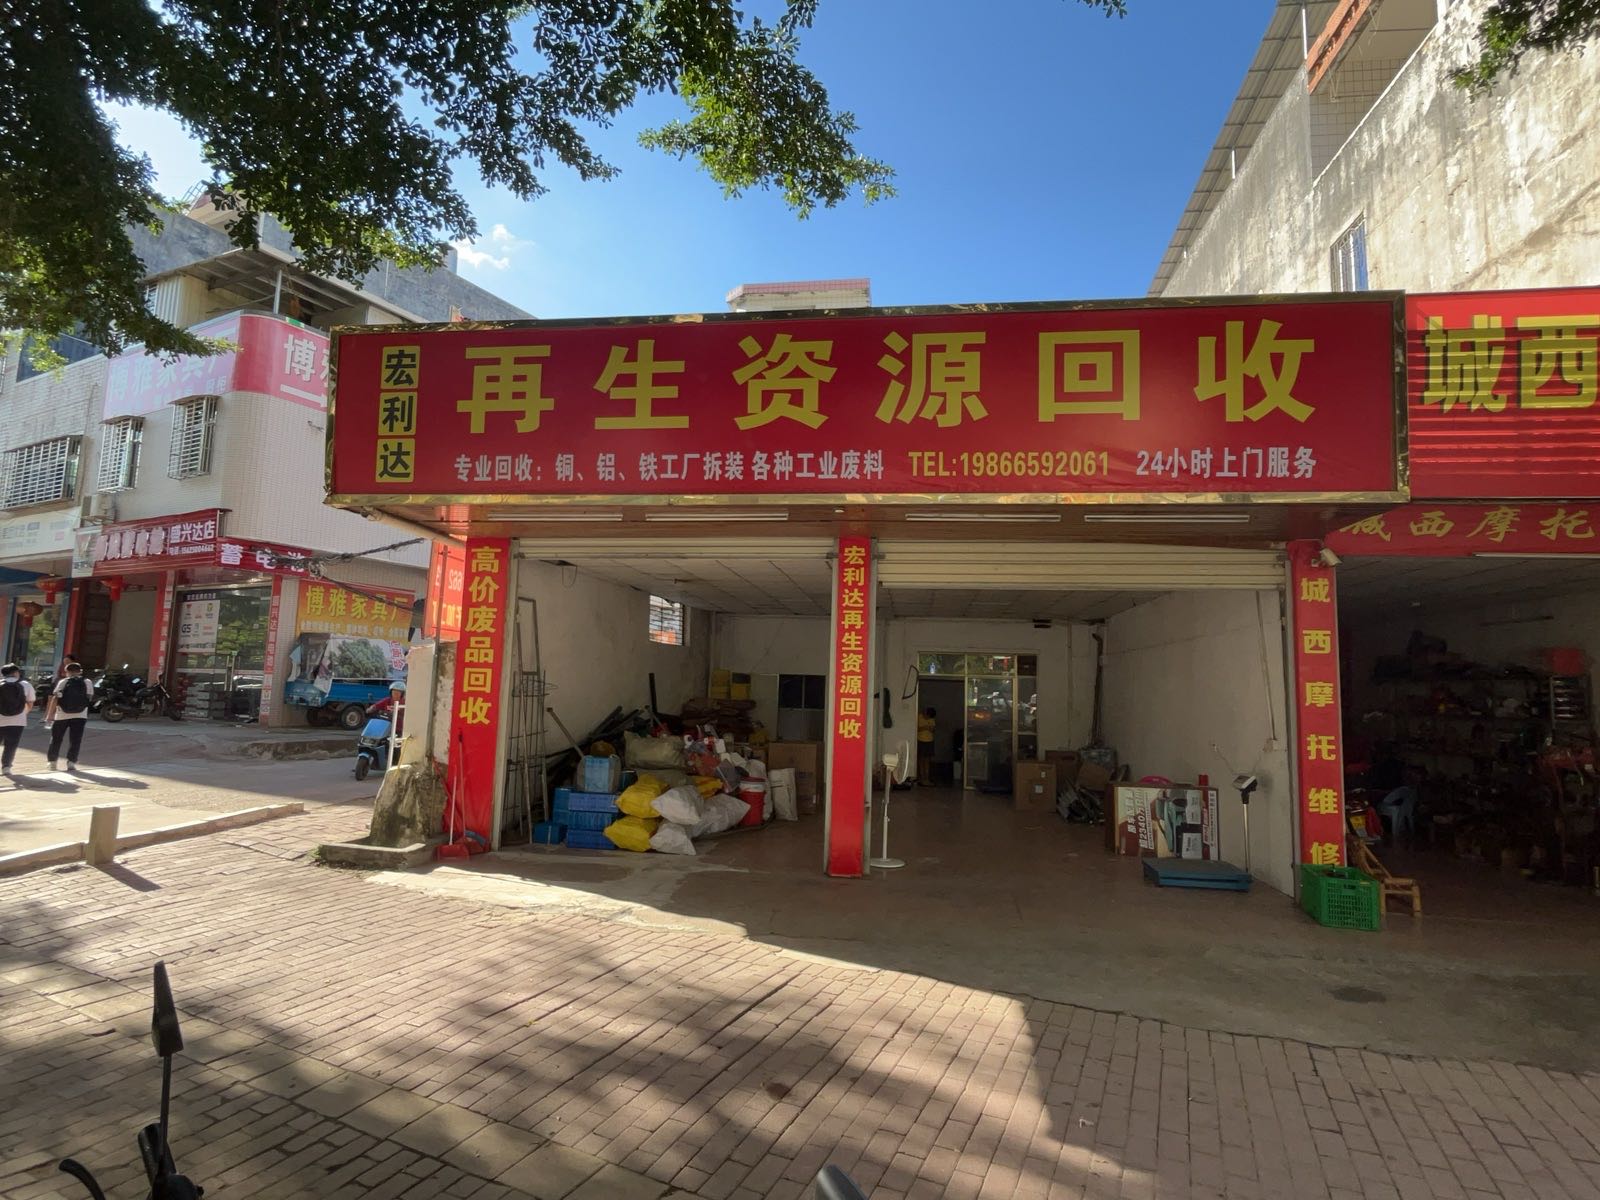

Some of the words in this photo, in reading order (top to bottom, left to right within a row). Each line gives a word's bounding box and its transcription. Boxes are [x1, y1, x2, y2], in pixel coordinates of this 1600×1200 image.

[377, 349, 418, 480] 宏利达
[456, 318, 1316, 434] 再生资源回收
[1423, 314, 1600, 413] 城西
[908, 450, 1109, 478] TEL:19866592061
[1136, 446, 1317, 479] 24小时上门服务
[306, 585, 409, 622] 博雅家具厂
[458, 545, 502, 726] 高价废品回收
[838, 545, 866, 740] 宏利达再生资源回收
[1300, 577, 1342, 866] 城西摩托维修
